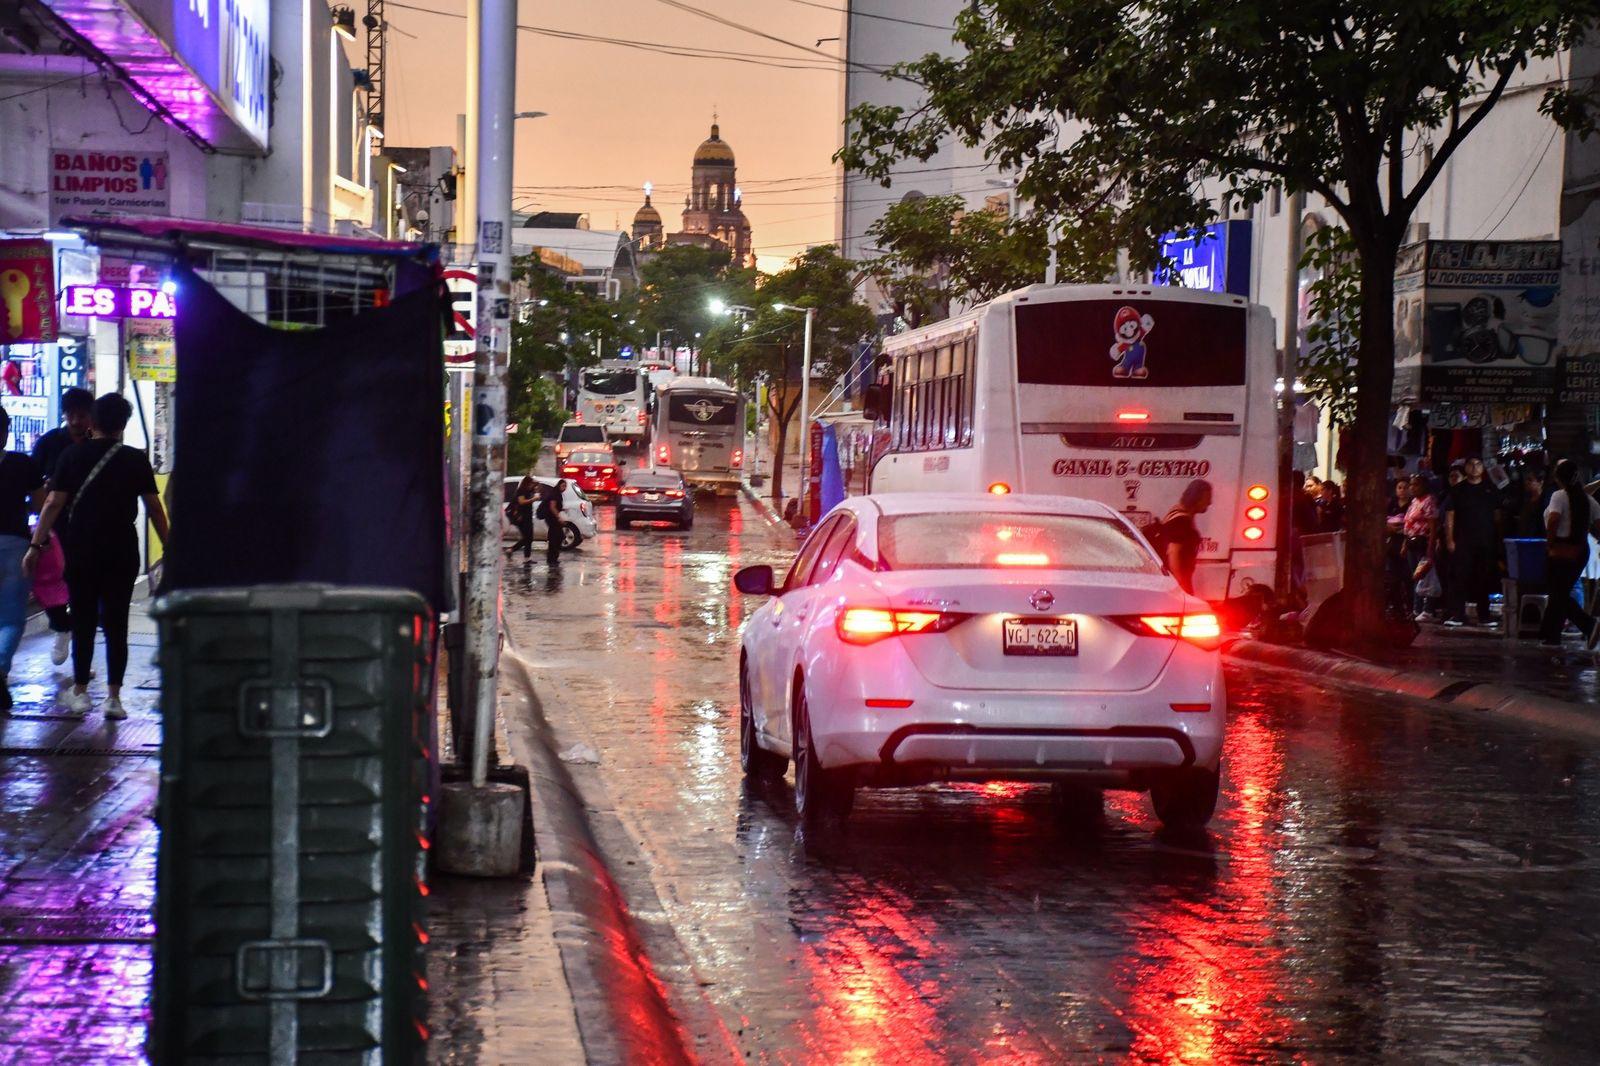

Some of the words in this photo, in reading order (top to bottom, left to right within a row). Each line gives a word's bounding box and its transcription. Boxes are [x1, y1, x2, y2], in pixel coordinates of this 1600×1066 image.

[54, 152, 138, 172] BAÑOS
[54, 175, 138, 193] LIMPIOS
[73, 197, 106, 206] Pasillo
[1430, 272, 1437, 284] Y
[1439, 272, 1504, 284] NOVEDADES
[1506, 272, 1560, 284] ROBERTO
[66, 287, 116, 315] ES
[1053, 458, 1113, 477] CANAL
[1126, 485, 1139, 500] 7
[1007, 628, 1074, 645] VGJ-622-D
